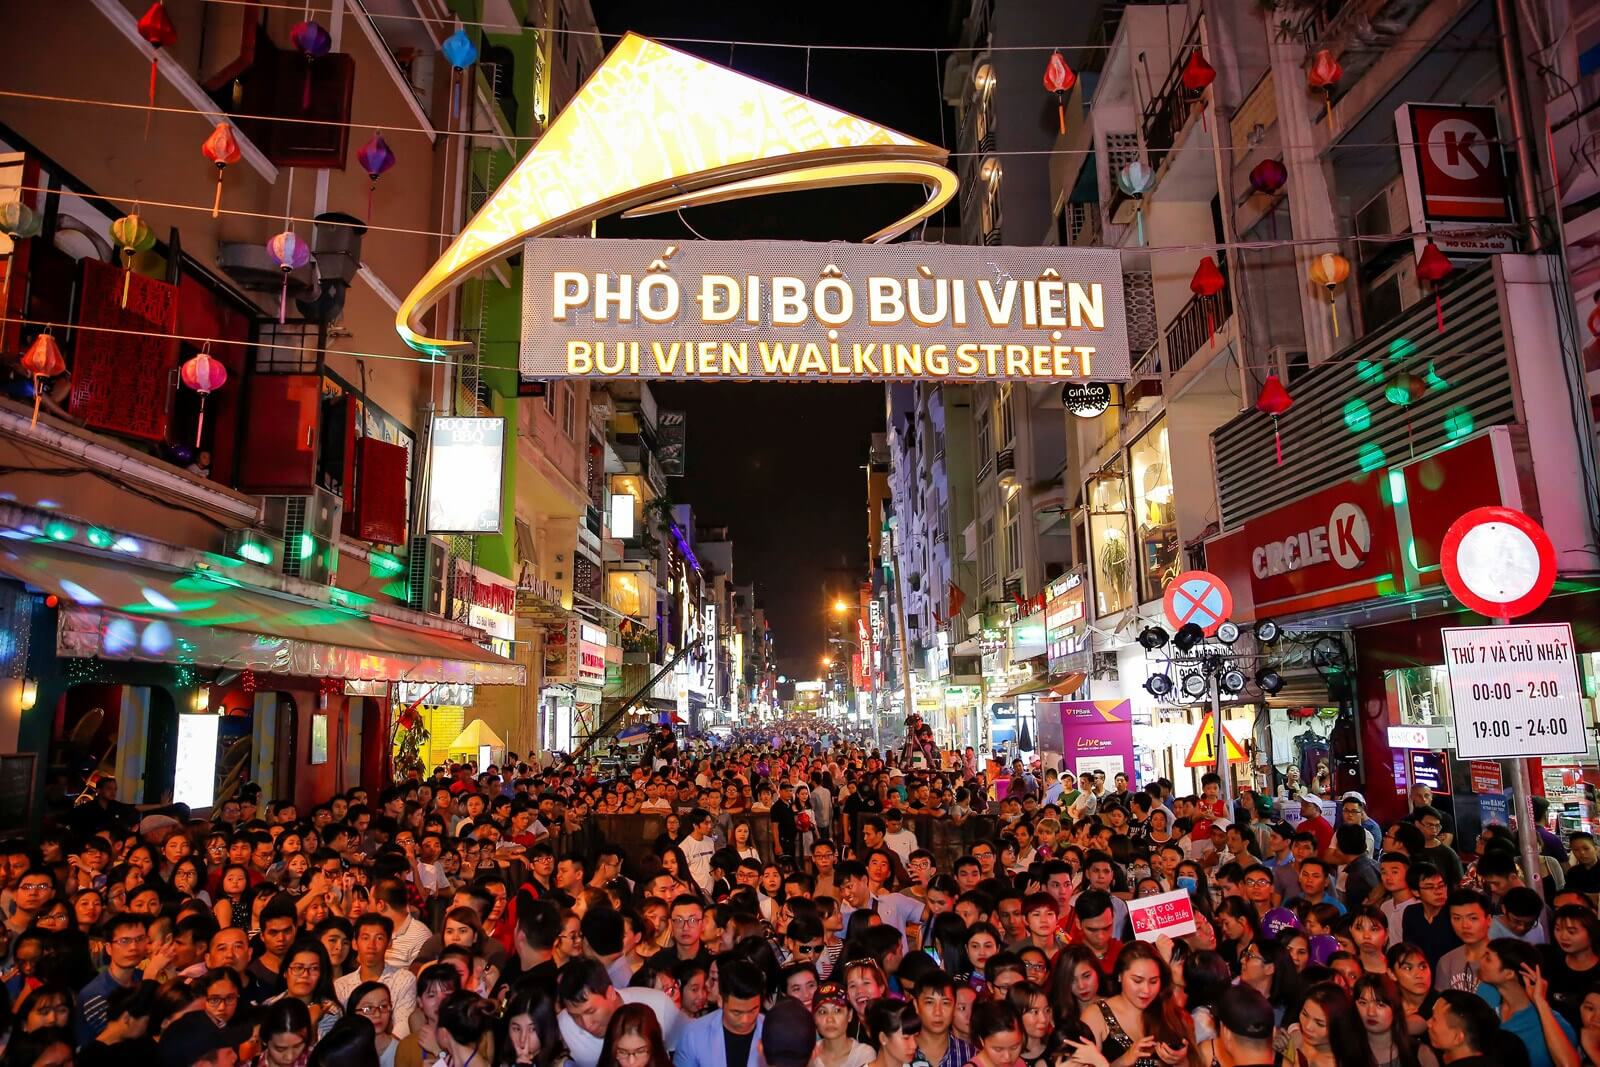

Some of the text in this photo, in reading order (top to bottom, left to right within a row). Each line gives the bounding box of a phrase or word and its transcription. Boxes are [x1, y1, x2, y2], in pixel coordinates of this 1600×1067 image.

[1443, 130, 1488, 177] K
[552, 244, 1105, 344] PHỐ ĐI BỘ BÙI VIỆN
[566, 340, 1097, 377] BUI VIEN WALKING STREET
[452, 431, 485, 443] BBQ
[1252, 525, 1331, 580] CIRCLE
[1452, 638, 1568, 664] THỨ 7 VÀ CHỦ NHẬT
[1473, 682, 1511, 701] 00:00
[1528, 681, 1558, 699] 2:00
[1472, 720, 1510, 738] 19:00
[1527, 718, 1568, 737] 24:00
[1077, 736, 1099, 747] Live
